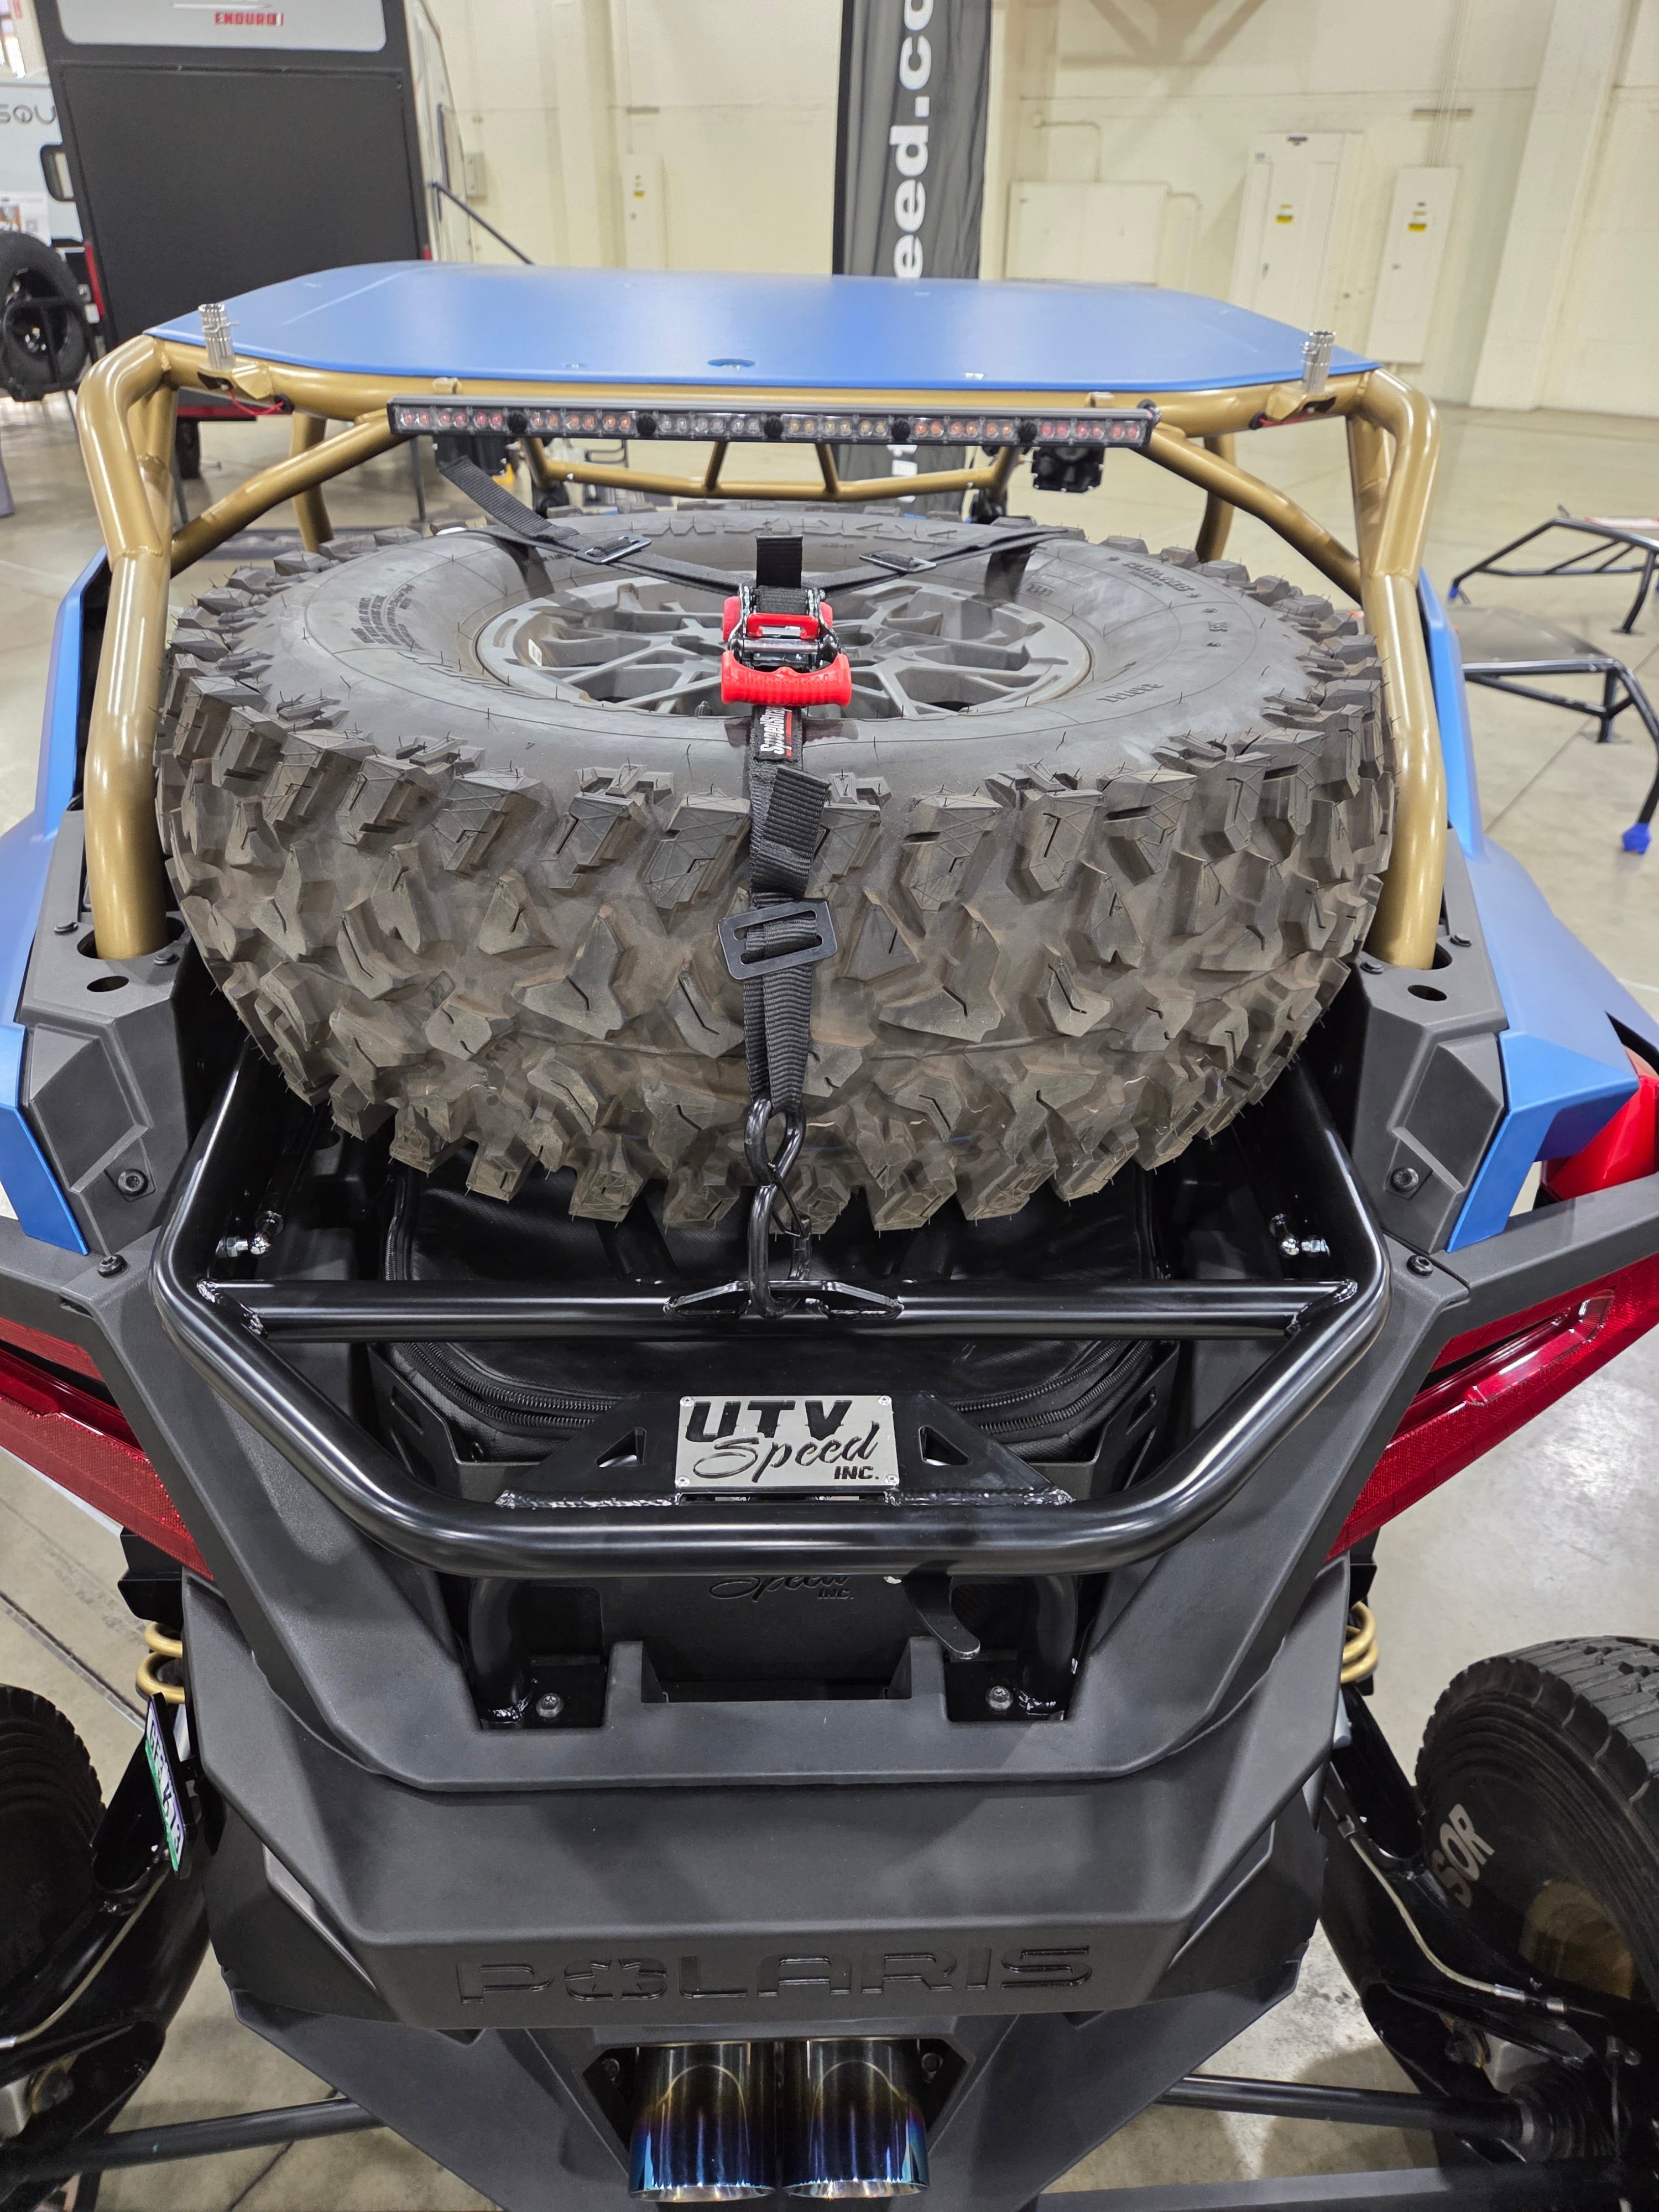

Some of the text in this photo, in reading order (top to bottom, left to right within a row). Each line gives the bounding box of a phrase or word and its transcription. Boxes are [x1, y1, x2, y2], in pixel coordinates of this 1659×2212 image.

[685, 1400, 853, 1443] UTV
[692, 1420, 880, 1483] Speed
[834, 1465, 879, 1480] INC.
[455, 1945, 1093, 2005] POLARIS
